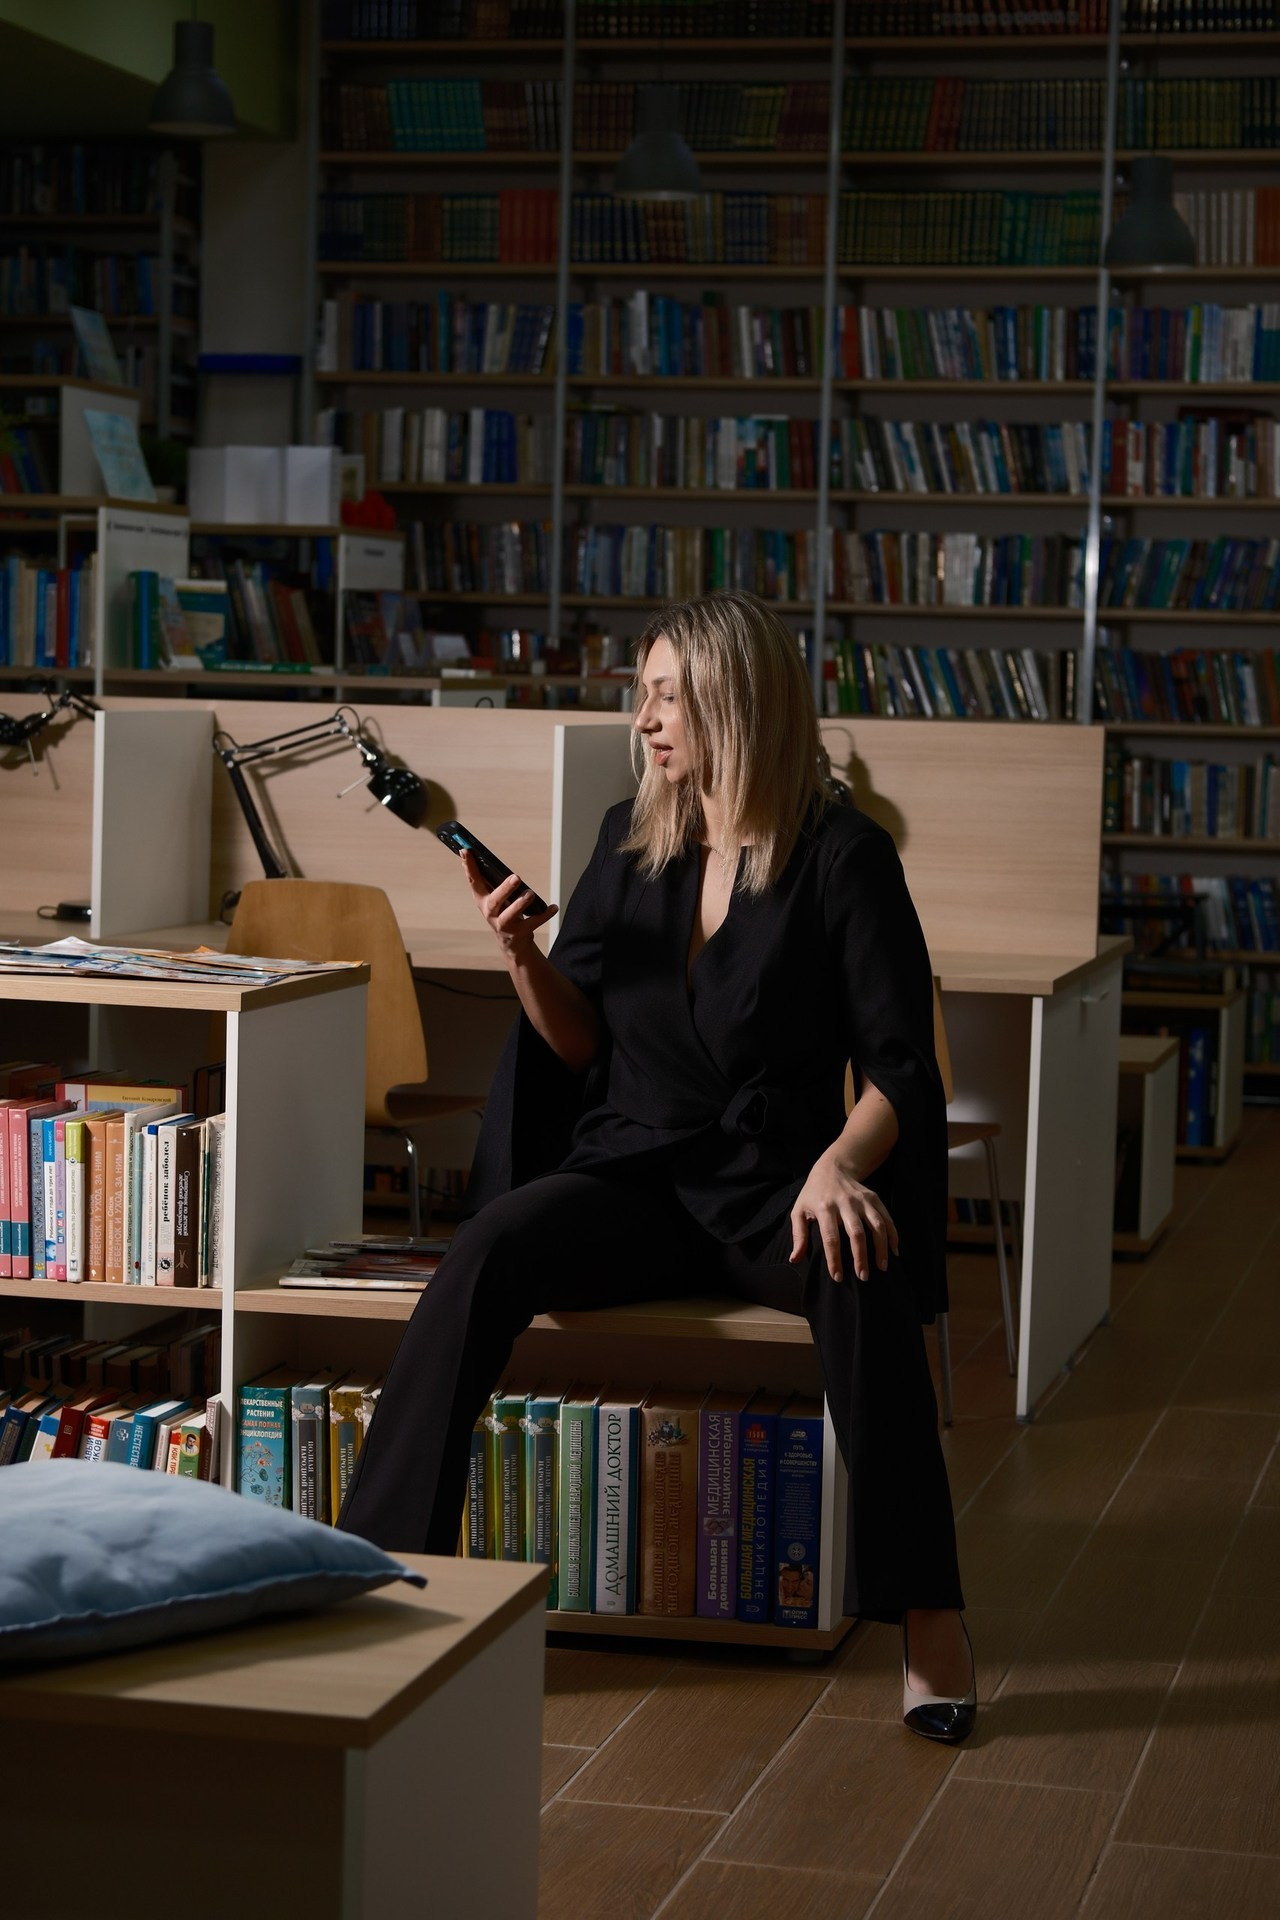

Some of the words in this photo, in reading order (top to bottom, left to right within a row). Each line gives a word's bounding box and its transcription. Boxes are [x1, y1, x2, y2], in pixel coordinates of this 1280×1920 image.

[95, 1174, 102, 1184] ЗА
[162, 1141, 170, 1180] заболел
[216, 1160, 221, 1169] ЗА
[94, 1188, 102, 1211] УХОД
[115, 1176, 122, 1187] ЗА
[114, 1190, 122, 1214] УХОД
[162, 1183, 170, 1222] ребёнок
[183, 1206, 188, 1214] по
[94, 1226, 102, 1266] РЕБЕНОК
[114, 1228, 122, 1268] РЕБЕНОК
[240, 1398, 283, 1408] ЛЕКАРСТВЕННЫЕ
[246, 1409, 274, 1418] РАСТЕНИЯ
[240, 1430, 282, 1439] ЭНЦИКЛОПЕДИЯ
[570, 1419, 583, 1462] МЕДИЦИНЫ
[606, 1413, 622, 1482] ДОКТОР
[568, 1463, 582, 1502] НАРОДНОЙ
[707, 1414, 721, 1515] МЕДИЦИНСКАЯ
[722, 1417, 732, 1514] энциклопедия
[742, 1458, 756, 1541] МЕДИЦИНСКАЯ
[544, 1492, 552, 1554] ЭНЦИКЛОПЕДИЯ
[568, 1504, 582, 1561] ЭНЦИКЛОПЕДИЯ
[604, 1485, 621, 1595] ДОМАШНИЙ
[755, 1458, 768, 1600] ЭНЦИКЛОПЕДИЯ
[568, 1563, 580, 1598] БОЛЬШАЯ
[708, 1539, 718, 1600] Большая
[719, 1538, 730, 1610] домашняя
[740, 1544, 753, 1600] БОЛЬШАЯ
